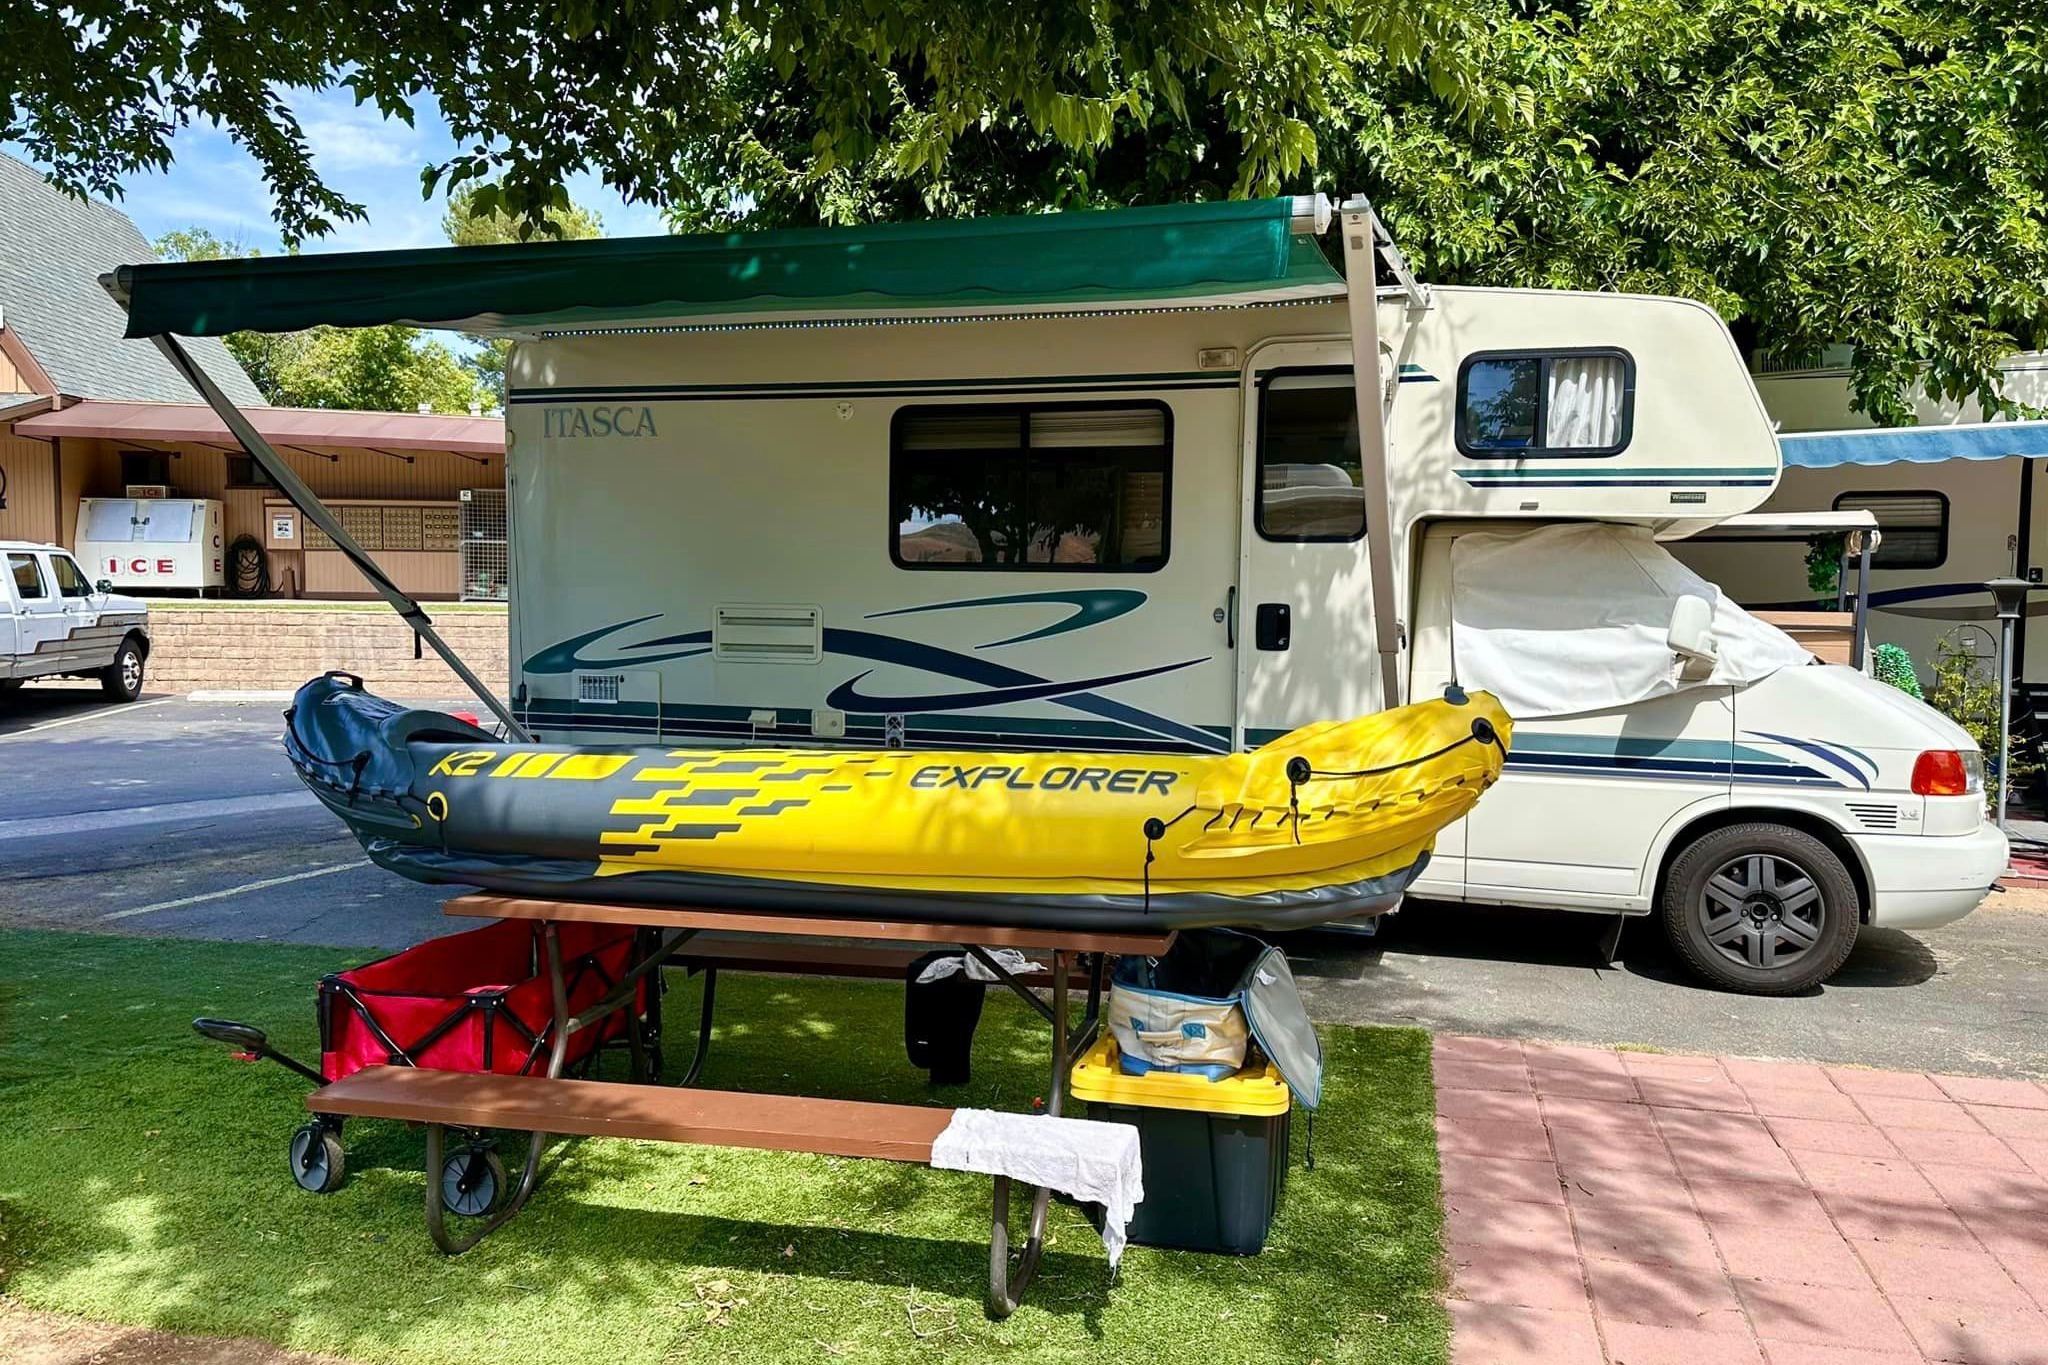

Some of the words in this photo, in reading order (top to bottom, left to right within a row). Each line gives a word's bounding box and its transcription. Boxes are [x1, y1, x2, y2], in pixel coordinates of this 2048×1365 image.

[543, 407, 658, 438] ITASCA
[213, 510, 221, 572] ICE
[109, 559, 173, 573] ICE
[428, 752, 496, 776] K2
[910, 766, 1178, 795] EXPLORER
